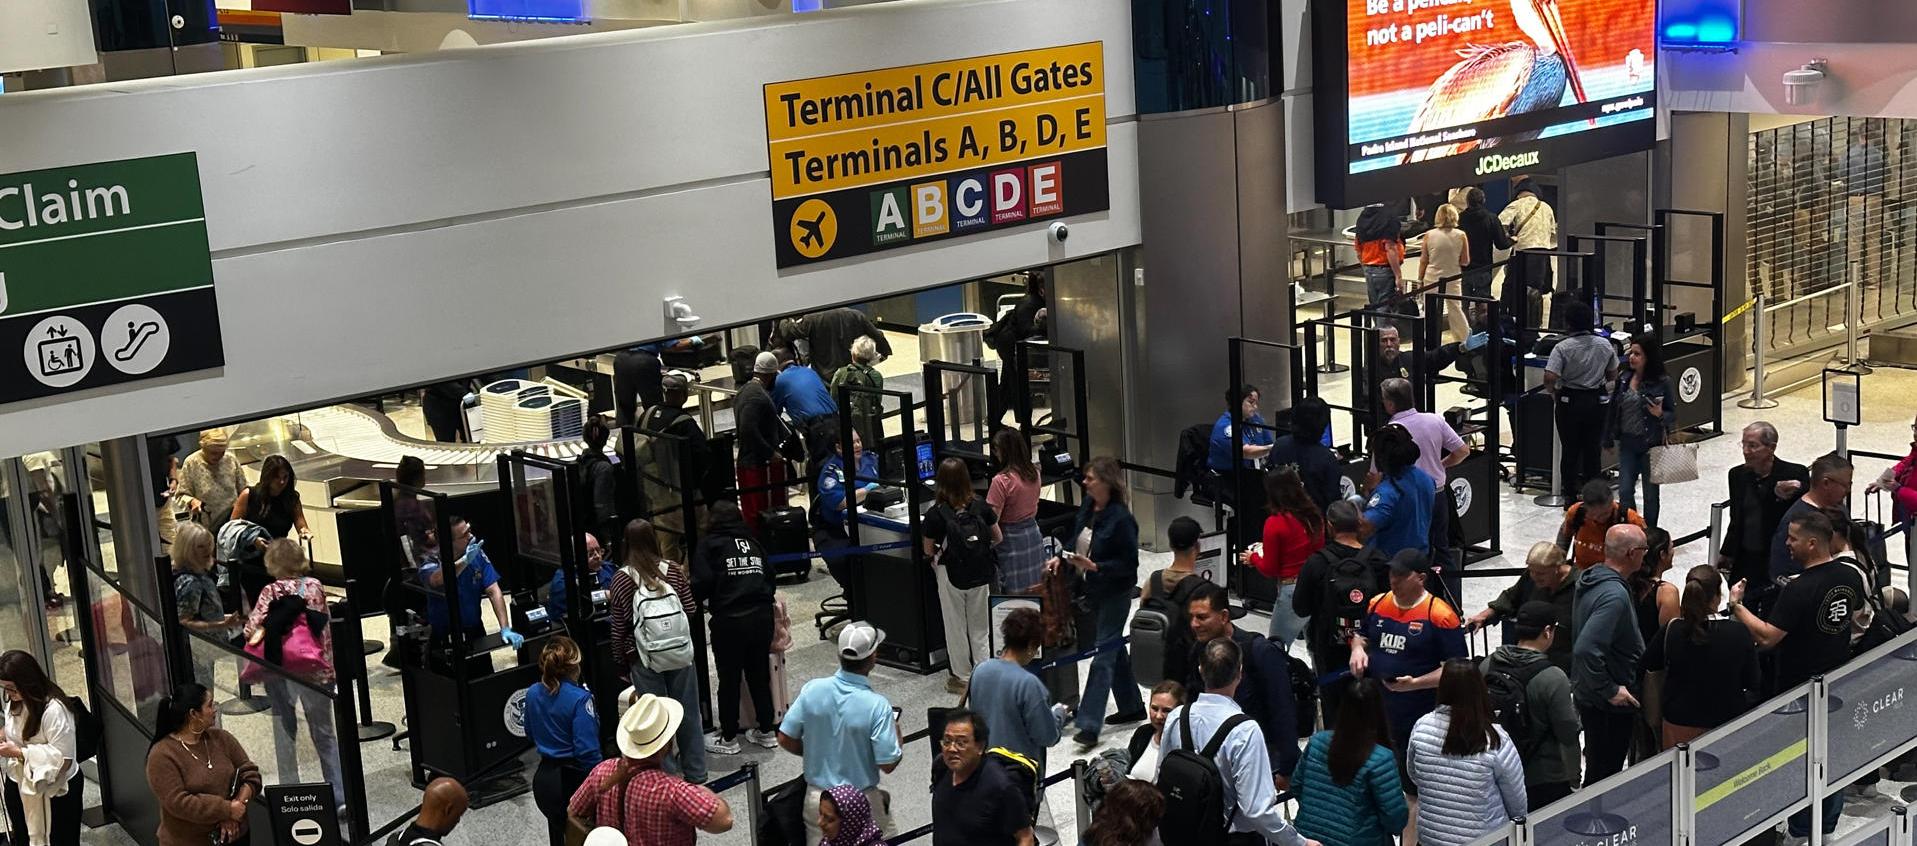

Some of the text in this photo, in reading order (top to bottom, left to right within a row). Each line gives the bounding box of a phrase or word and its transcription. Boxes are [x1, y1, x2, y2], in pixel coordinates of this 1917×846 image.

[1366, 0, 1388, 15] Be
[1367, 9, 1494, 46] not a peli-can't
[780, 61, 1093, 127] Terminal C/All Gates
[785, 107, 1091, 184] Terminals A, B, D, E
[1475, 151, 1539, 176] JCDecaux
[0, 179, 130, 230] Claim
[876, 166, 1057, 233] A B C D E
[1032, 203, 1061, 215] TERMINAL
[957, 217, 985, 228] TERMINAL
[995, 211, 1023, 221] TERMINAL
[877, 231, 907, 242] TERMINAL
[1872, 688, 1904, 713] CLEAR
[283, 793, 317, 803] Exit only
[280, 804, 323, 813] Solo salida
